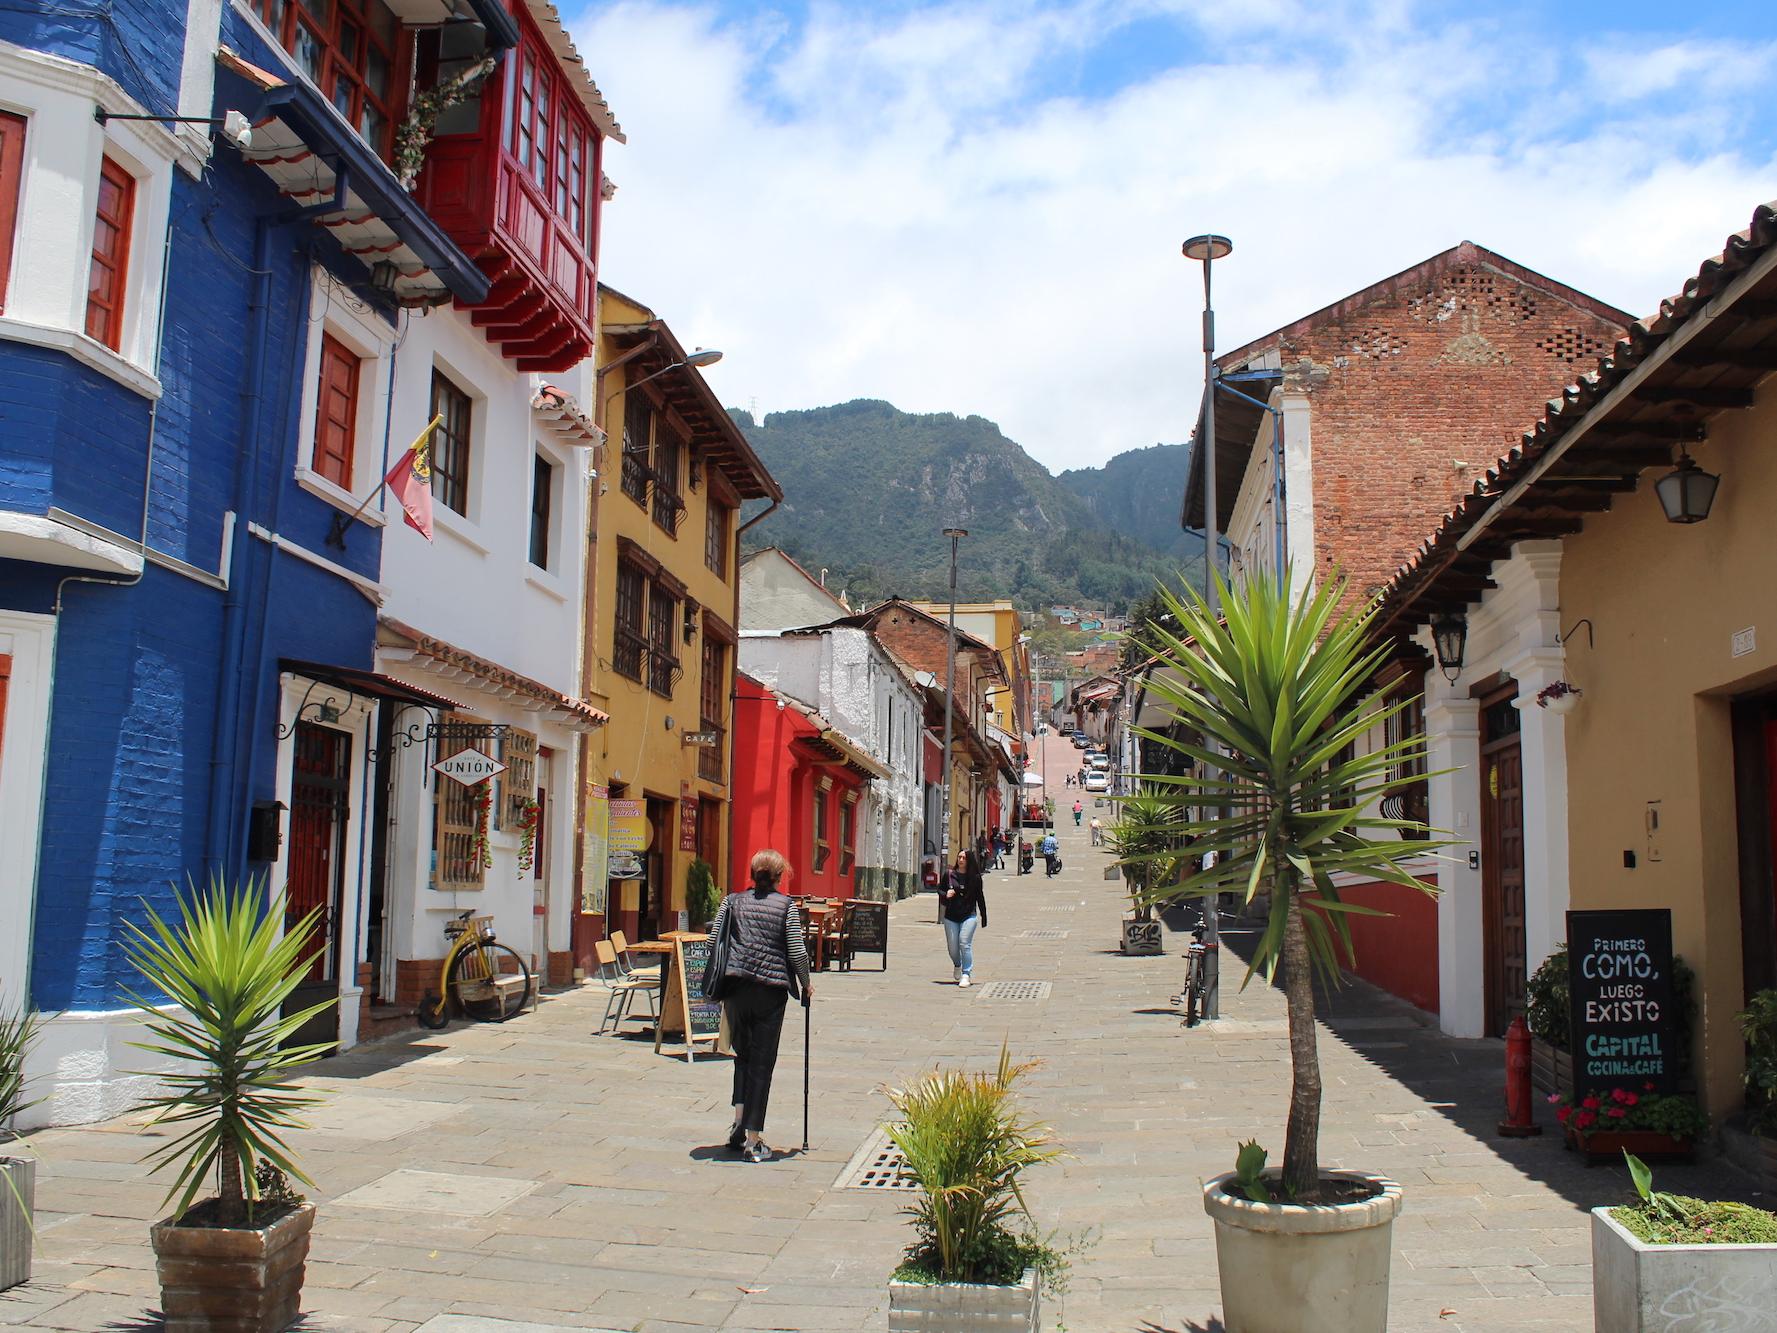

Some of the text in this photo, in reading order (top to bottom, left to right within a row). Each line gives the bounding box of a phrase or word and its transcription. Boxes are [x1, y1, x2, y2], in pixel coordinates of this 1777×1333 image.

[445, 760, 494, 773] UNIÓN
[1583, 952, 1659, 980] COMO,
[1600, 984, 1644, 999] LUEGO
[1586, 1033, 1662, 1057] CAPITAL
